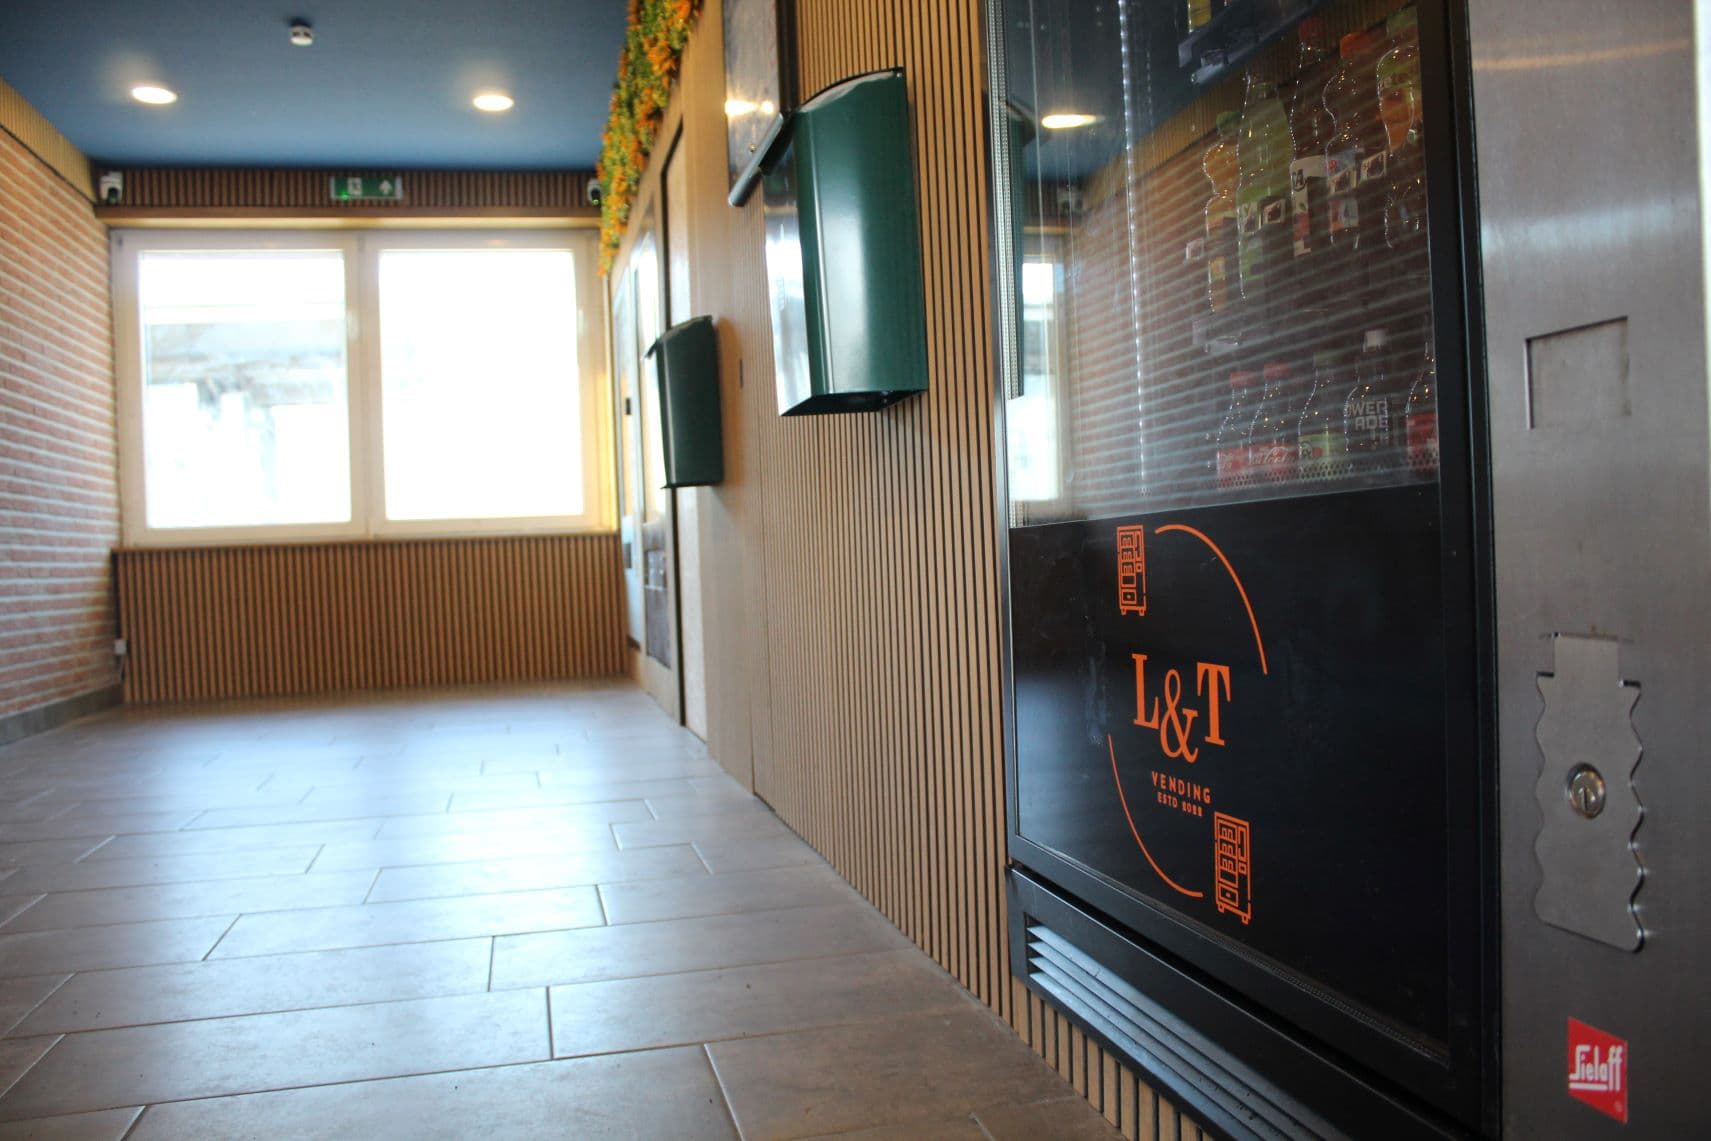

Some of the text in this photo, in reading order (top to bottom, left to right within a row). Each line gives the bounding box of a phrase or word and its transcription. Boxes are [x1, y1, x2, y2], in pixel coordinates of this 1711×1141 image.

[1131, 653, 1231, 763] L&T
[1151, 770, 1211, 805] VENDING
[1157, 791, 1178, 808] ESTD
[1568, 1045, 1622, 1091] Sielaff
